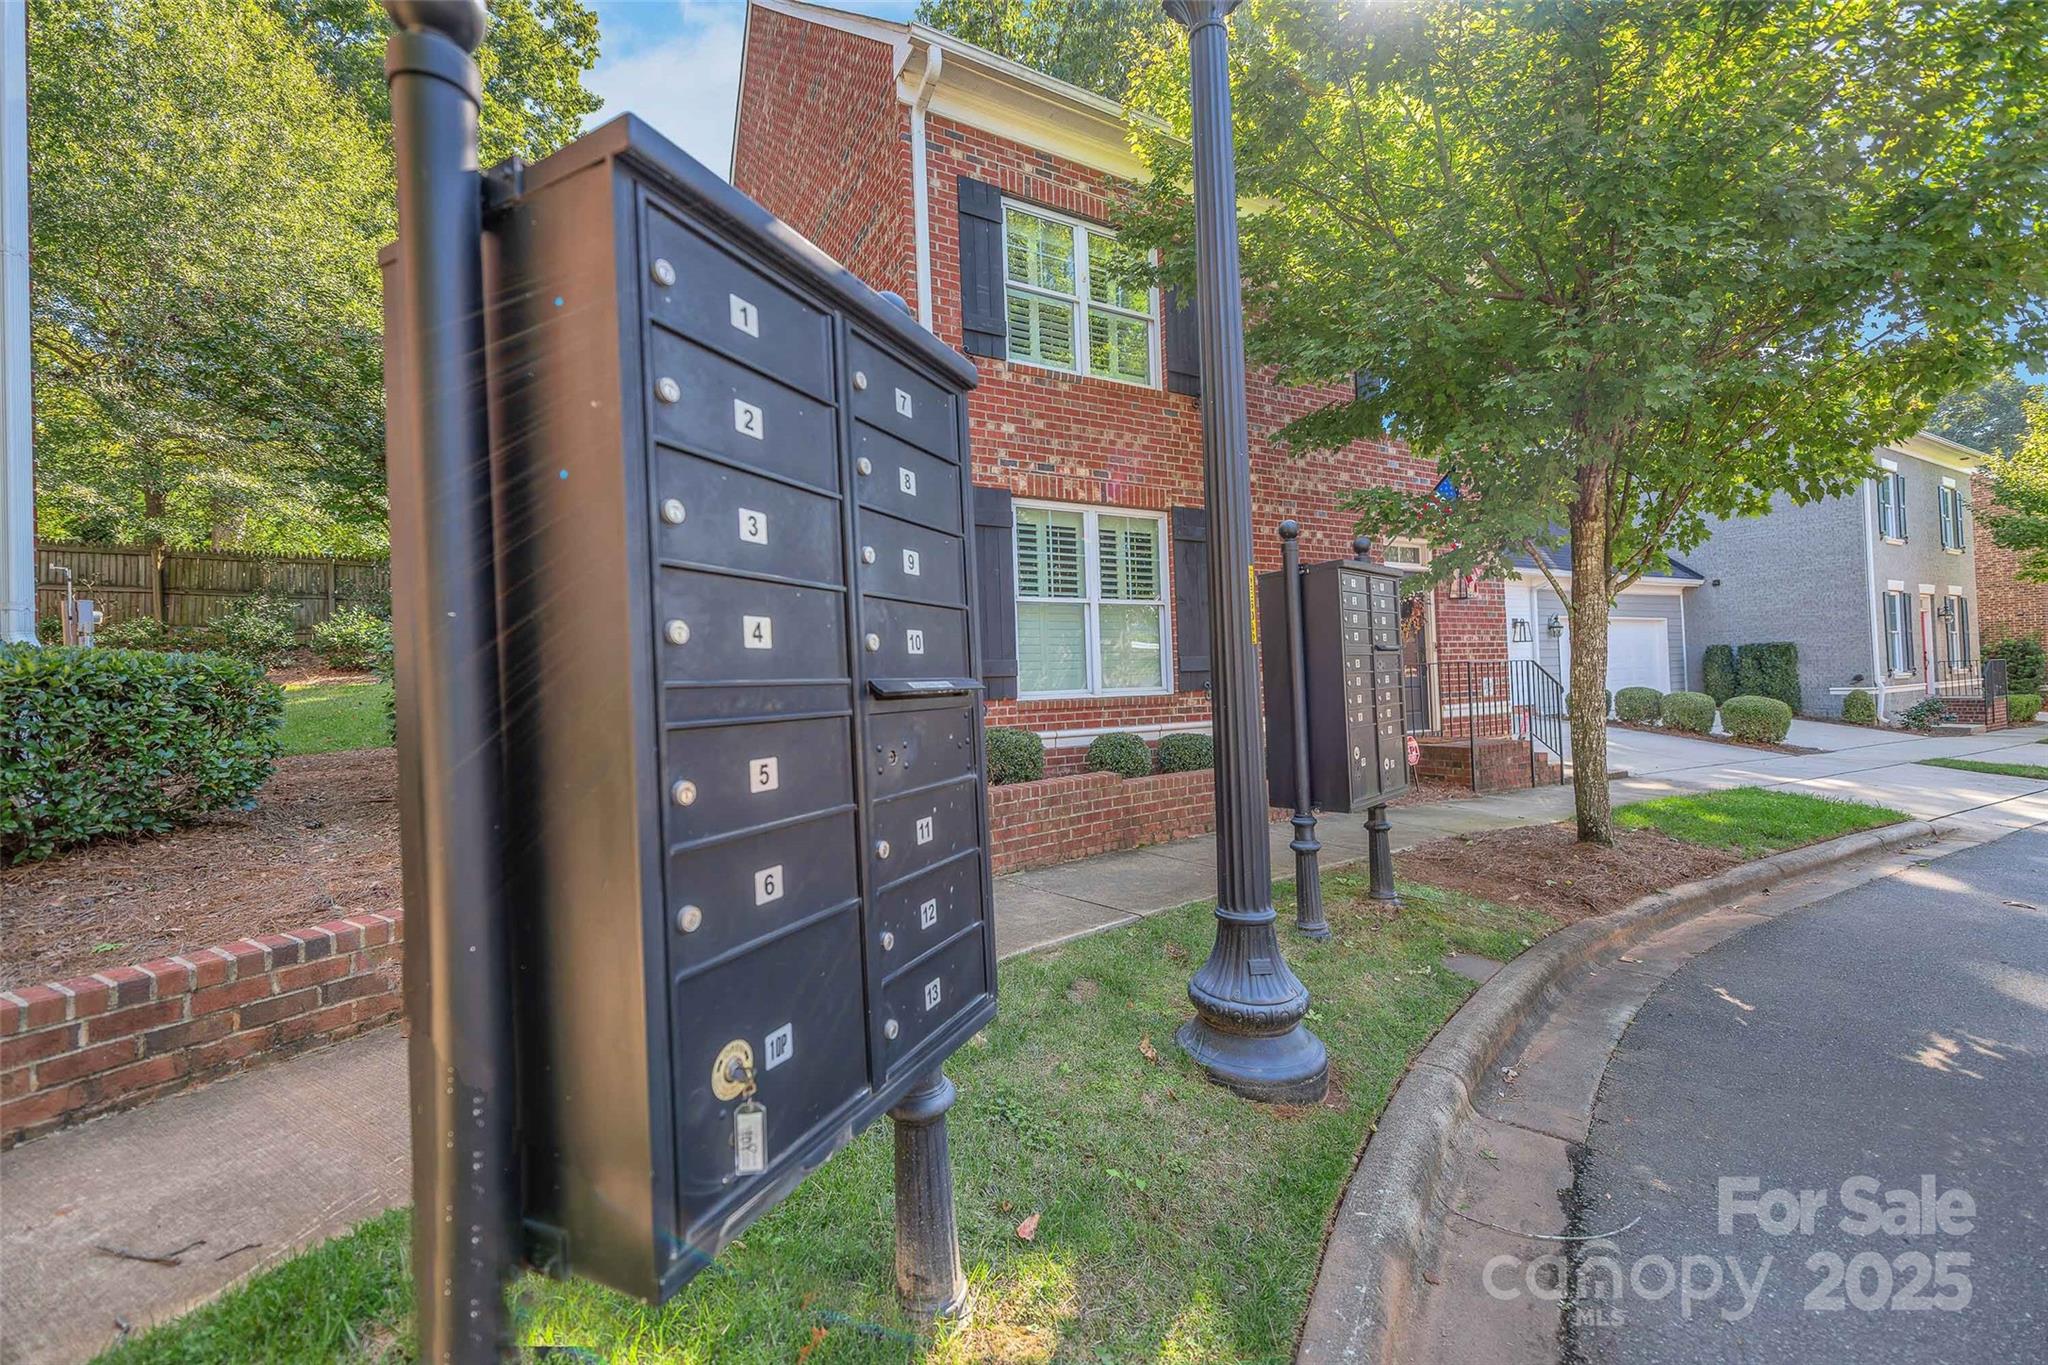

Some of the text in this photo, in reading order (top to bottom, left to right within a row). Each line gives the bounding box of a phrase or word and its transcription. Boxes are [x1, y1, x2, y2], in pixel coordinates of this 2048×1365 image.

[740, 307, 748, 328] 1
[900, 394, 907, 411] 7
[744, 409, 755, 431] 2
[904, 473, 911, 490] 8
[748, 515, 758, 537] 3
[908, 554, 915, 570] 9
[752, 622, 763, 643] 4
[909, 634, 921, 651] 10
[760, 764, 769, 785] 5
[919, 821, 930, 841] 11
[764, 874, 775, 896] 6
[923, 904, 935, 923] 12
[927, 984, 938, 1005] 13
